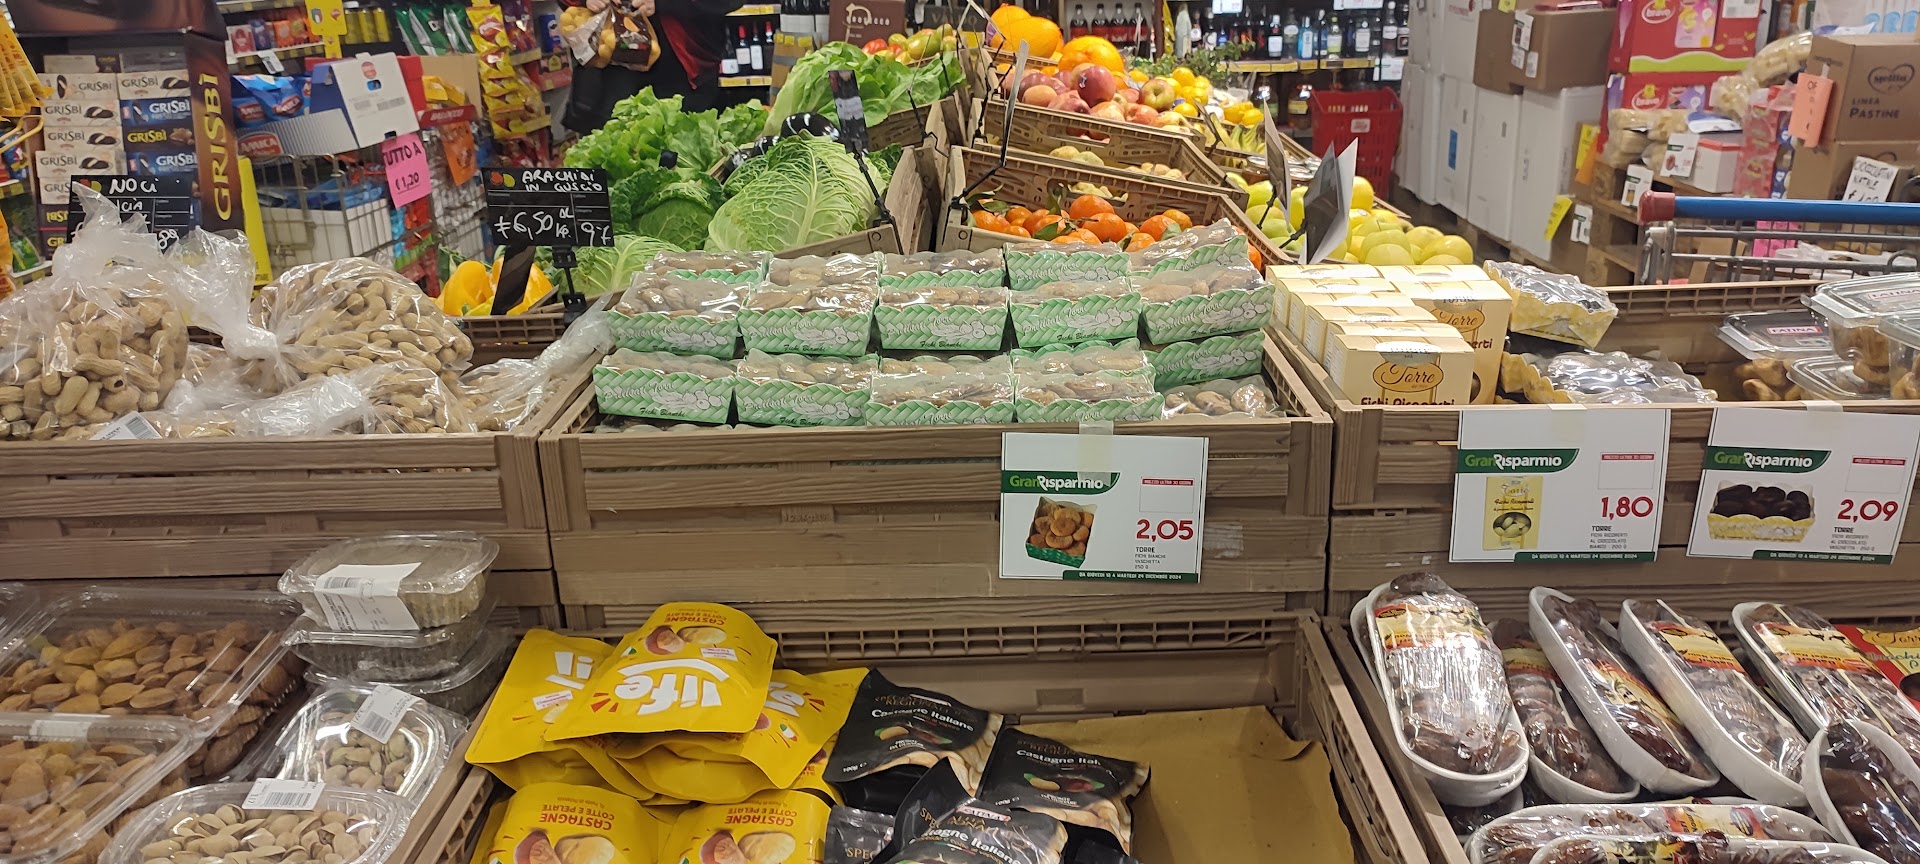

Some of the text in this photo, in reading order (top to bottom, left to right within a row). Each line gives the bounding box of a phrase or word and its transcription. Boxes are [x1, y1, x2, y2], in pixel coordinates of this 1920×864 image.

[1849, 108, 1900, 119] PASTINE
[198, 73, 231, 221] GRISBÌ
[382, 142, 422, 166] TUTTO A
[526, 183, 540, 192] IN
[494, 211, 554, 241] €6,50
[1440, 310, 1478, 327] Torre
[1381, 363, 1435, 385] Torre
[639, 407, 658, 416] Fichi
[1465, 454, 1562, 470] GranRisparmio
[1714, 451, 1813, 469] GranRisparmio
[1009, 475, 1104, 491] GranRisparmio
[1601, 496, 1654, 521] 1,80
[1837, 498, 1899, 523] 2,09
[1136, 518, 1194, 543] 2,05
[664, 617, 725, 626] CASTAGNE
[703, 613, 728, 621] COTTE
[614, 674, 722, 716] life
[930, 711, 974, 732] Italiane
[1016, 749, 1075, 765] Castagne
[542, 804, 576, 813] PELATE
[586, 808, 615, 820] COTTE
[728, 806, 760, 814] PELATE
[769, 808, 797, 818] COTTE
[539, 813, 612, 831] CASTAGNE
[725, 815, 794, 827] CASTAGNE
[970, 837, 1021, 864] Italiane
